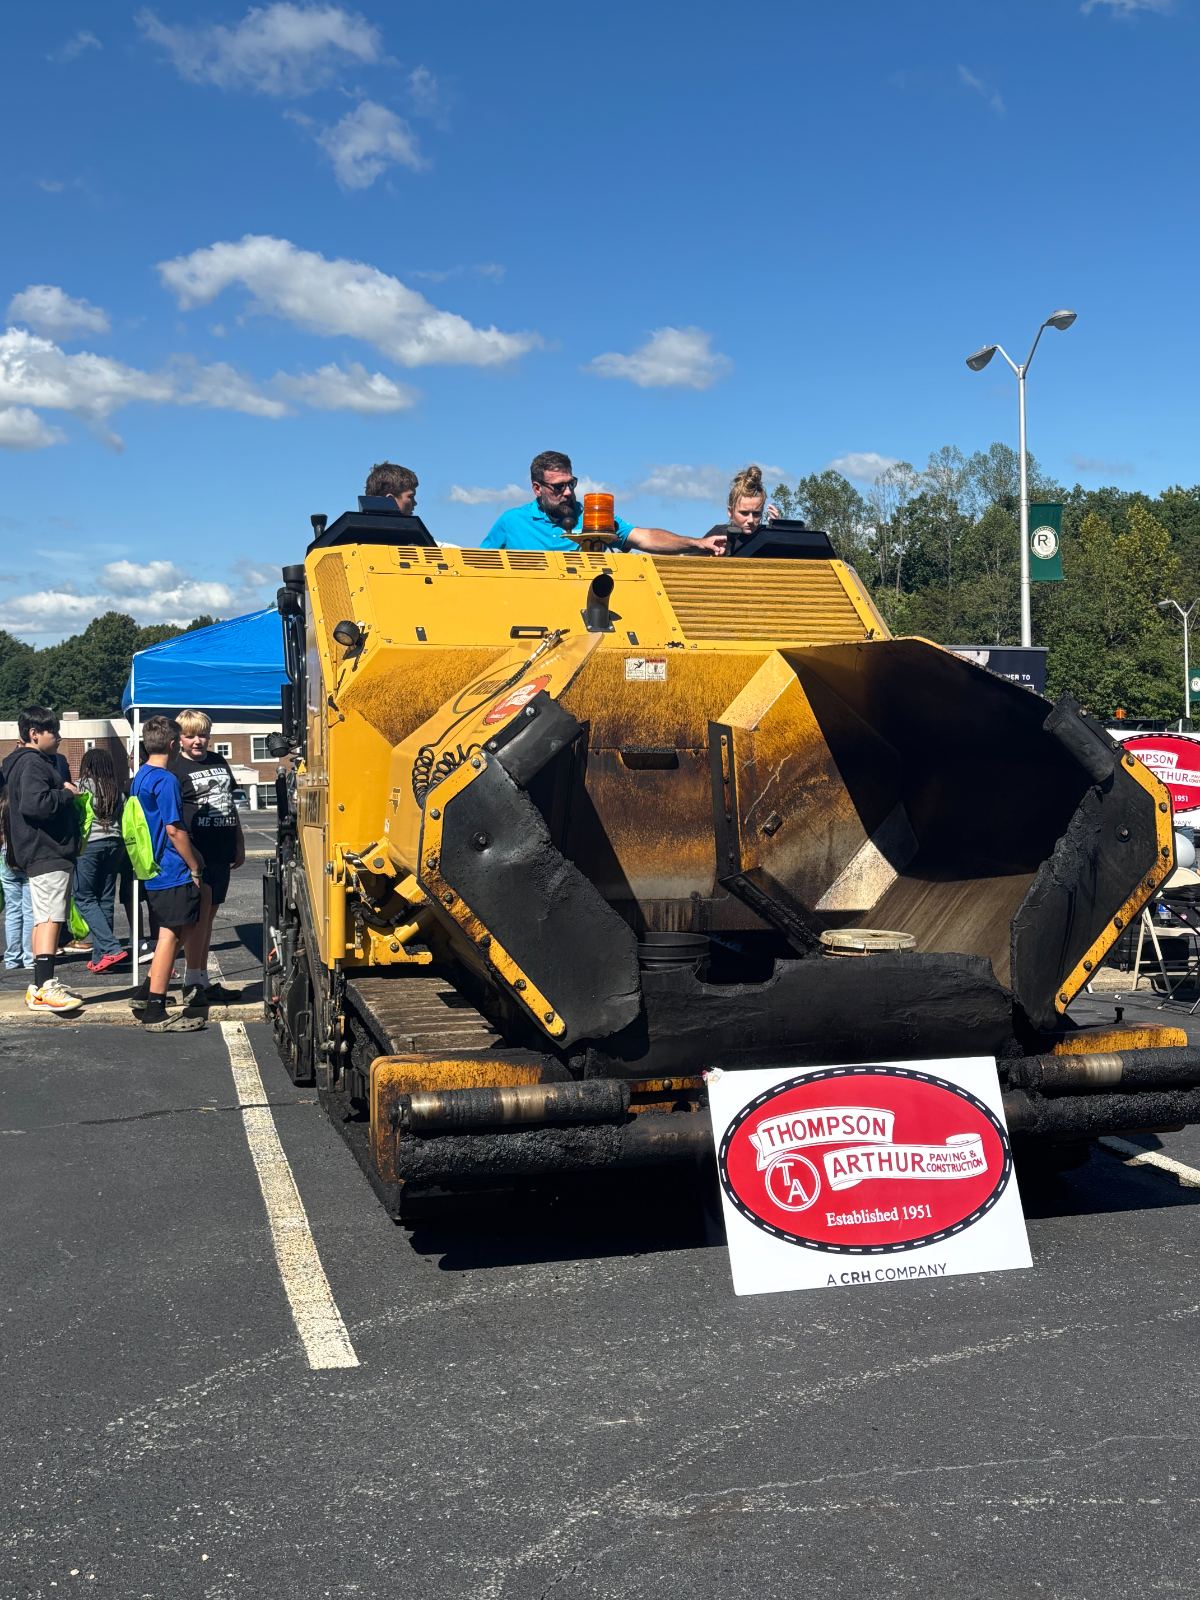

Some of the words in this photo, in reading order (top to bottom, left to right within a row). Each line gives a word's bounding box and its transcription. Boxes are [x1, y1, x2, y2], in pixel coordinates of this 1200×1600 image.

[1037, 534, 1048, 546] R
[1174, 795, 1189, 803] 1951
[197, 816, 211, 827] ME
[762, 1115, 886, 1147] THOMPSON
[929, 1151, 967, 1163] PAVING
[969, 1149, 977, 1158] &
[833, 1151, 926, 1178] ARTHUR
[926, 1158, 984, 1174] CONSTRUCTION
[825, 1206, 899, 1227] Established
[901, 1204, 933, 1220] 1951
[826, 1273, 837, 1287] A
[840, 1270, 872, 1285] CRH
[874, 1262, 947, 1282] COMPANY
